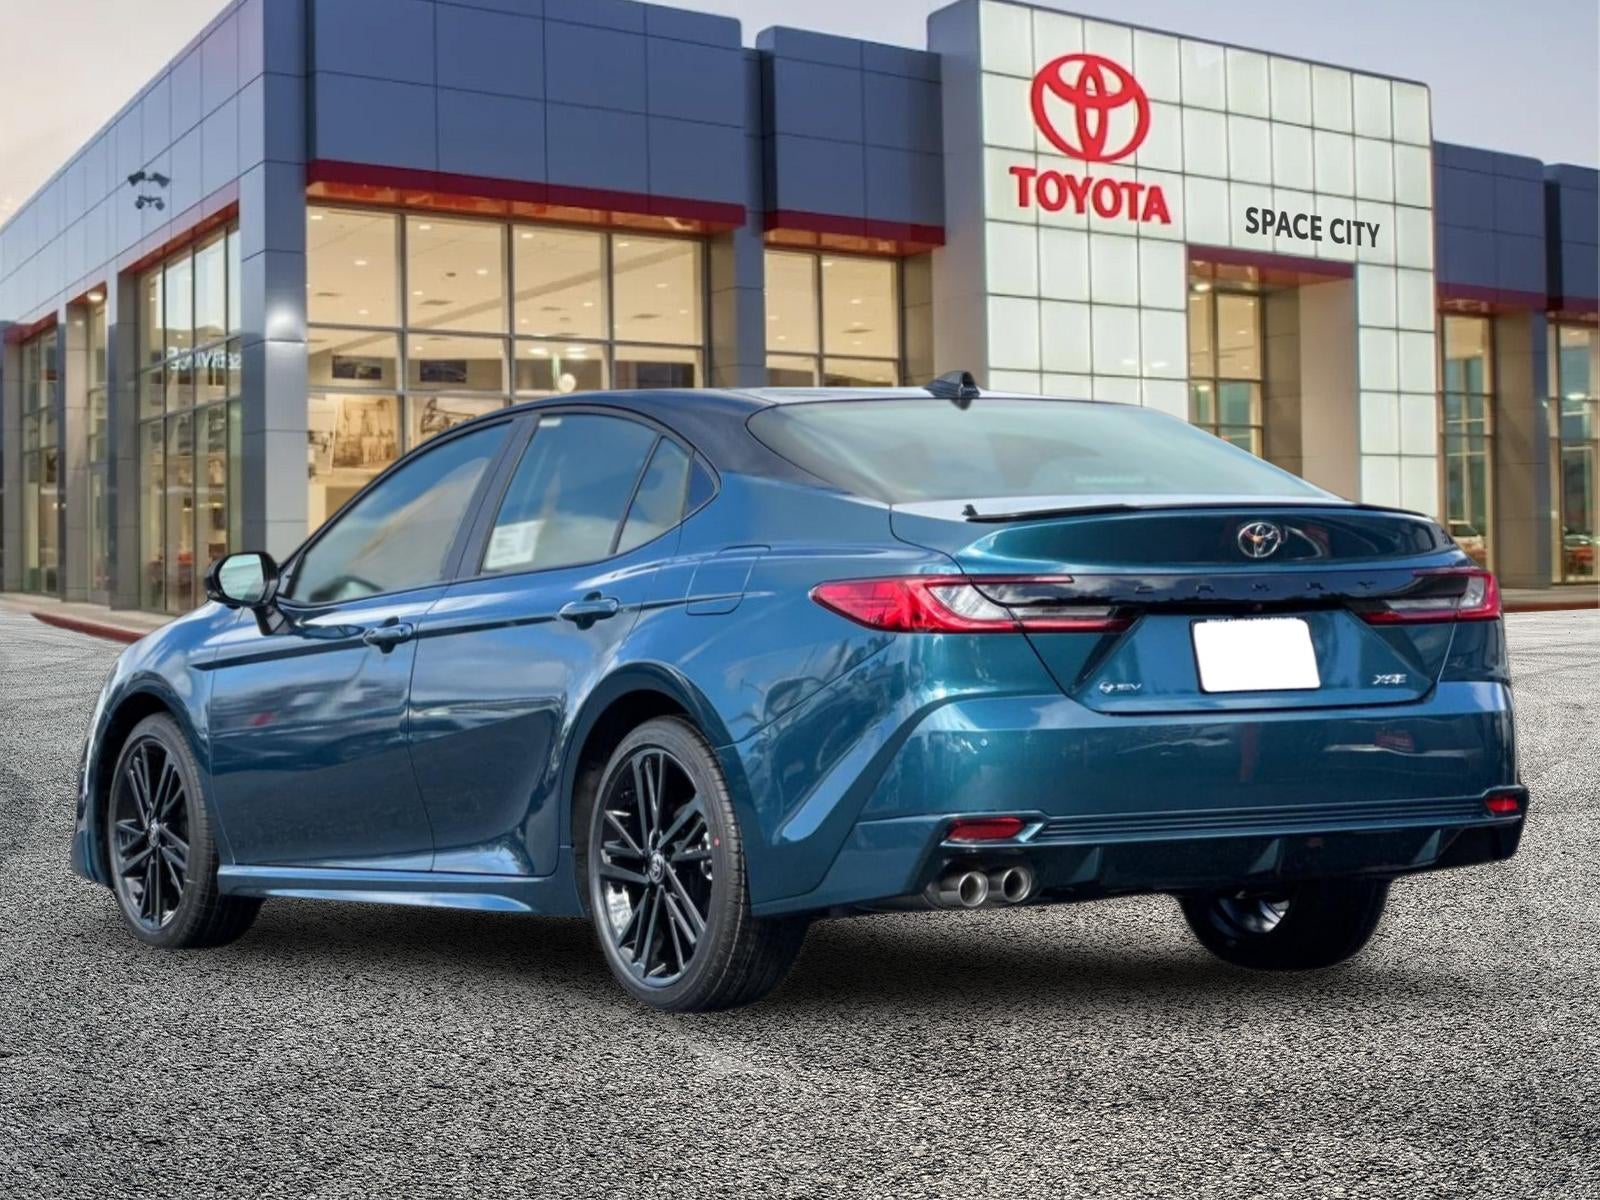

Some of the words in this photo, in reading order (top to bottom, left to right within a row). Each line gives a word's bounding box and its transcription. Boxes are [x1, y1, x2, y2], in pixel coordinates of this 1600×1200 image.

[1008, 165, 1172, 225] TOYOTA
[1245, 206, 1323, 242] SPACE
[1329, 218, 1381, 248] CITY
